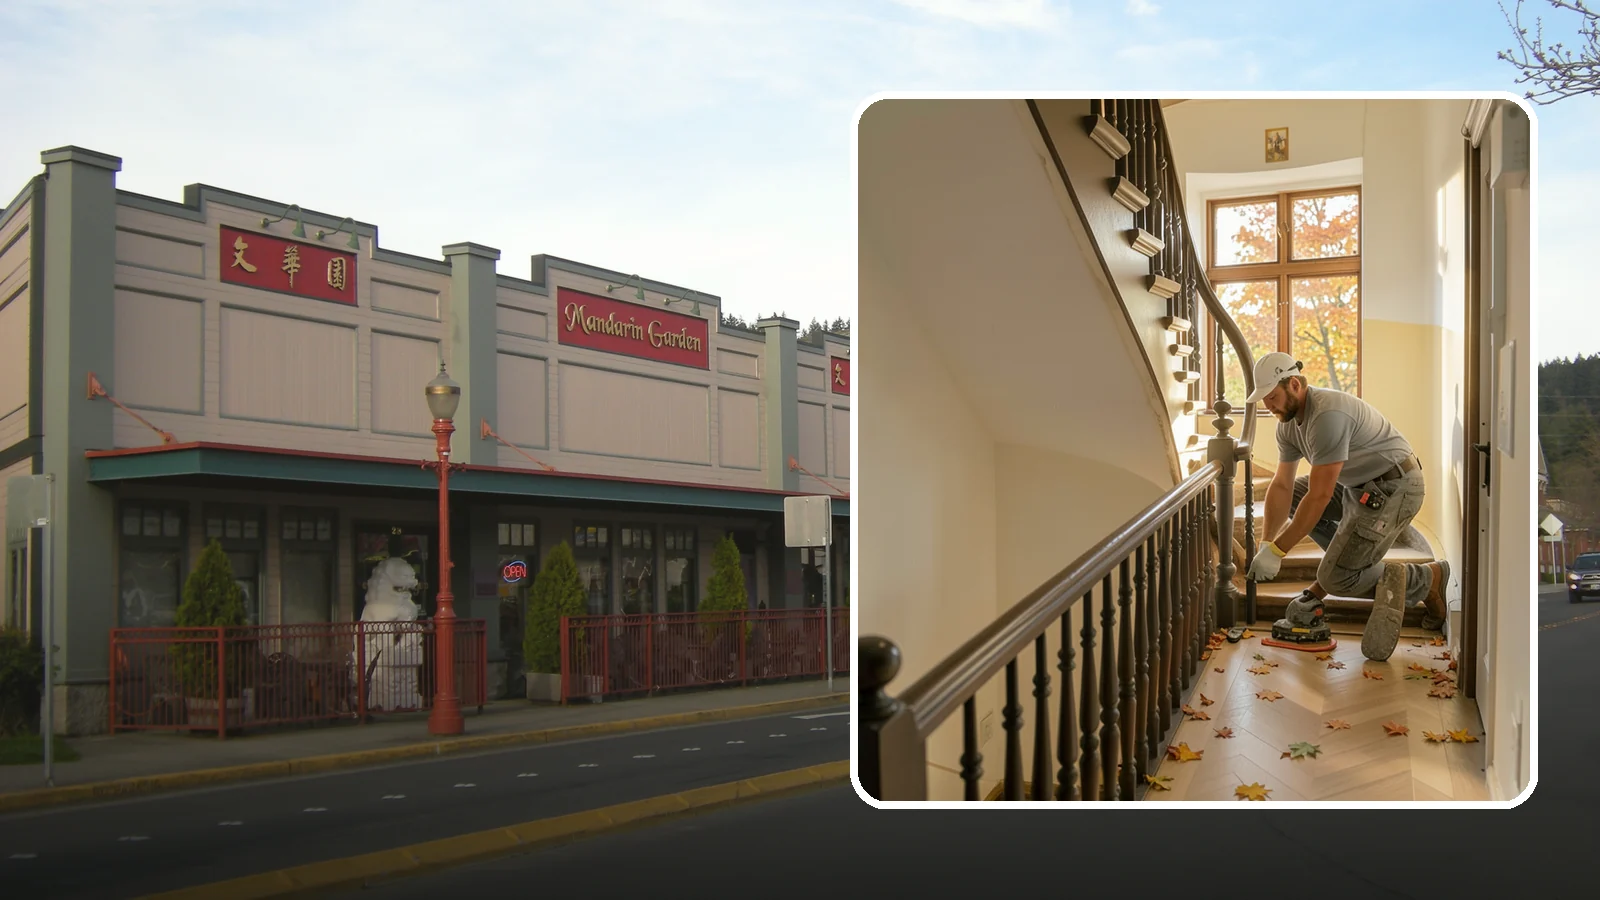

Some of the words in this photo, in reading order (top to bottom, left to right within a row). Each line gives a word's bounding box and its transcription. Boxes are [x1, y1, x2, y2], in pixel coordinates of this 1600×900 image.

[231, 236, 347, 291] 文華園
[564, 302, 644, 341] Mandarin
[648, 320, 702, 352] Garden
[503, 565, 527, 578] OPEN
